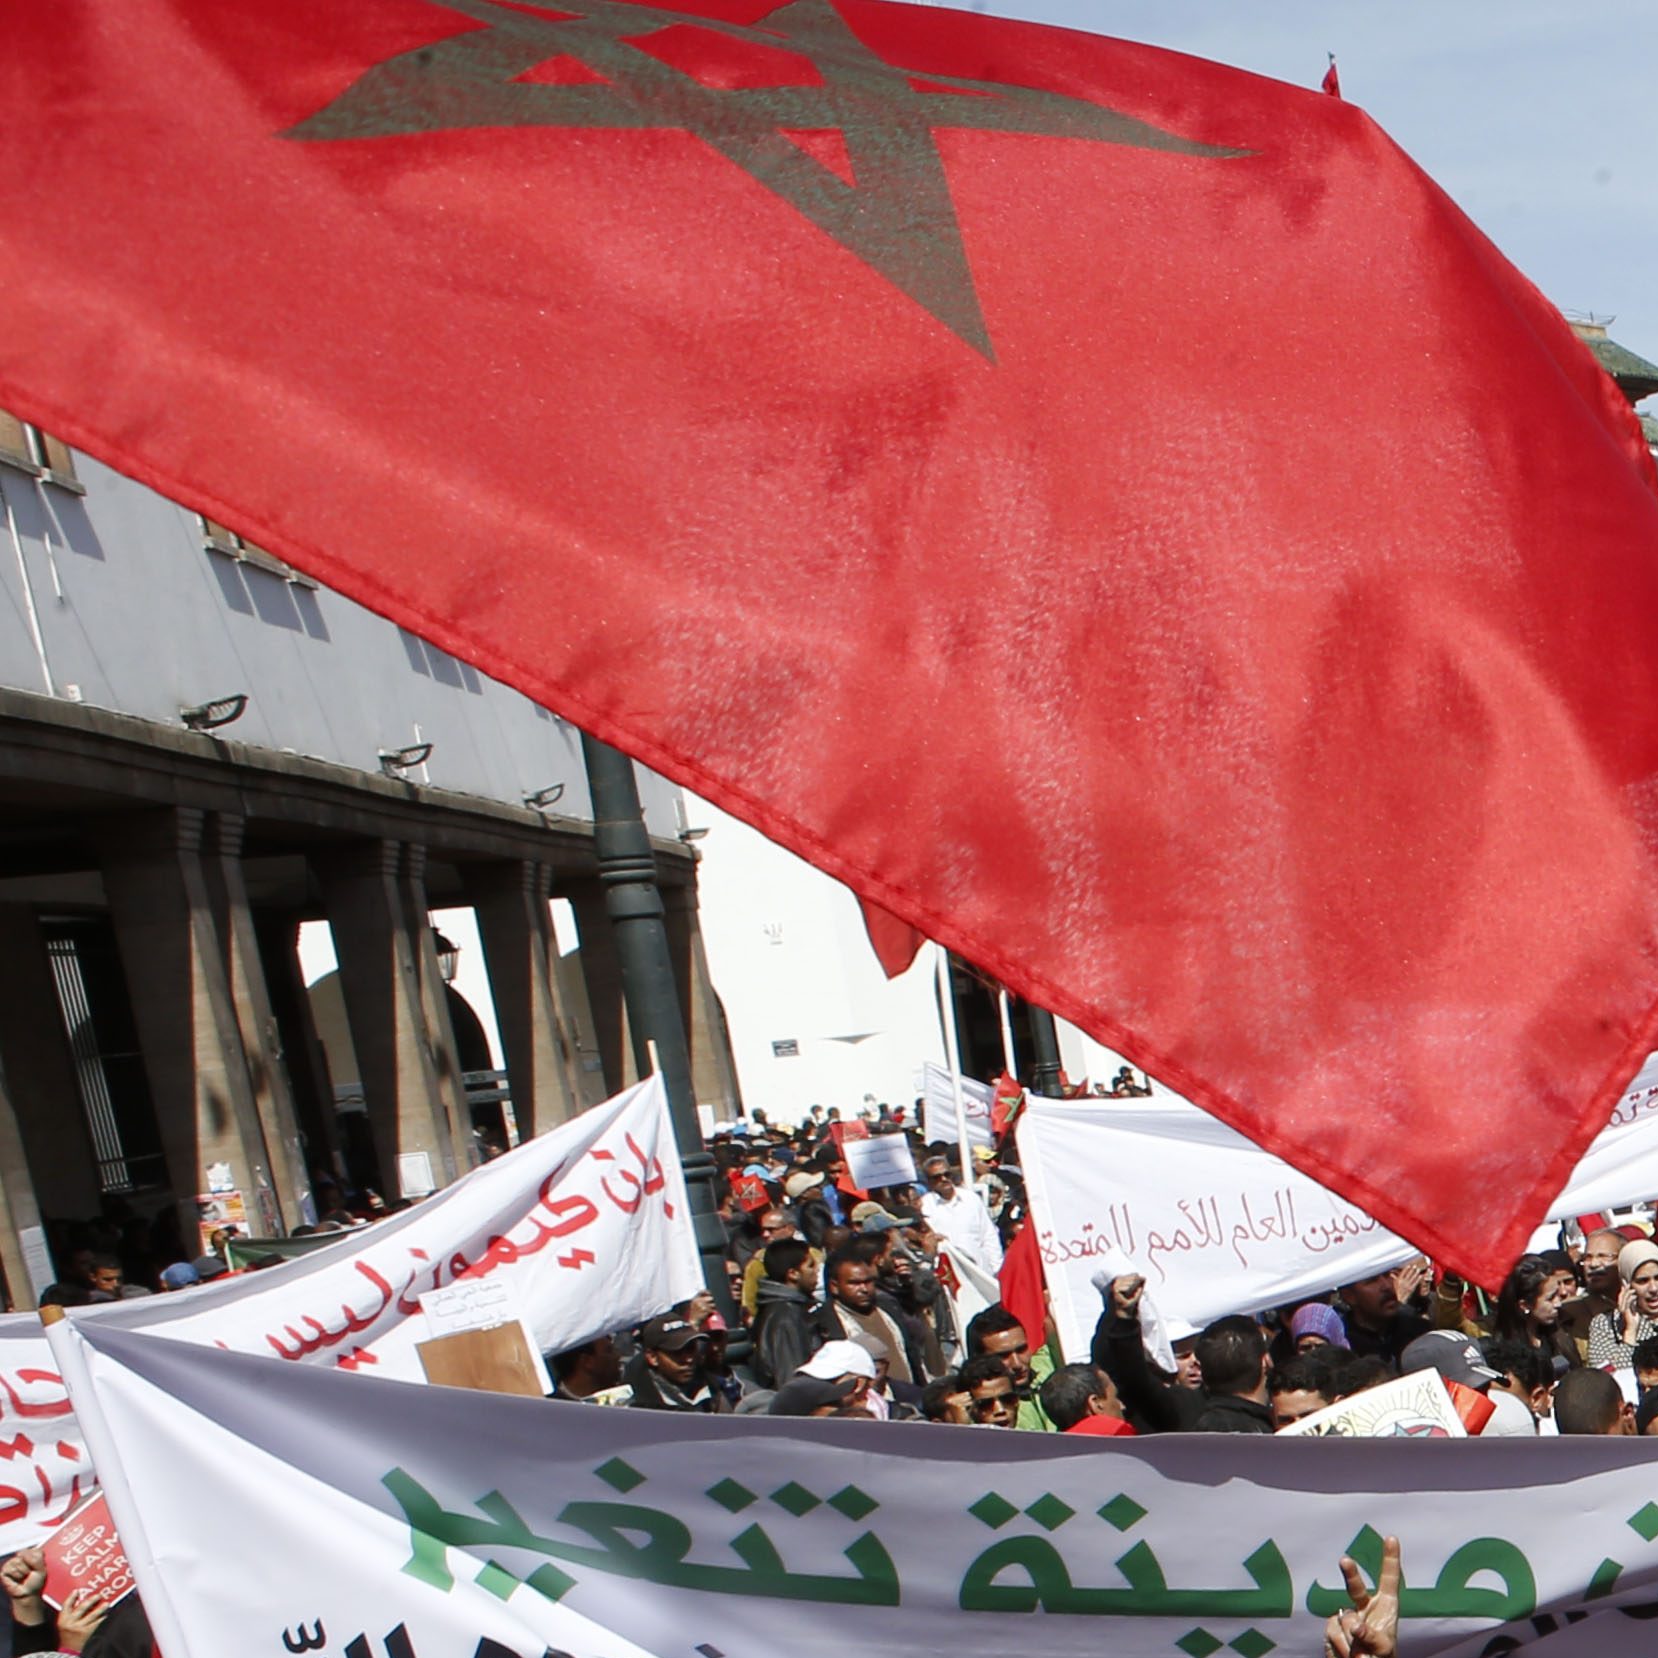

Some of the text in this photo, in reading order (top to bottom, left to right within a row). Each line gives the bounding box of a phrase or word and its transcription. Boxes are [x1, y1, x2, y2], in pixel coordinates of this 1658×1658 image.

[1147, 1195, 1225, 1284] للأمم
[1231, 1187, 1298, 1269] العام
[61, 1524, 105, 1566] KEEP
[378, 1455, 902, 1606] تنغير
[74, 1555, 129, 1608] AHAR
